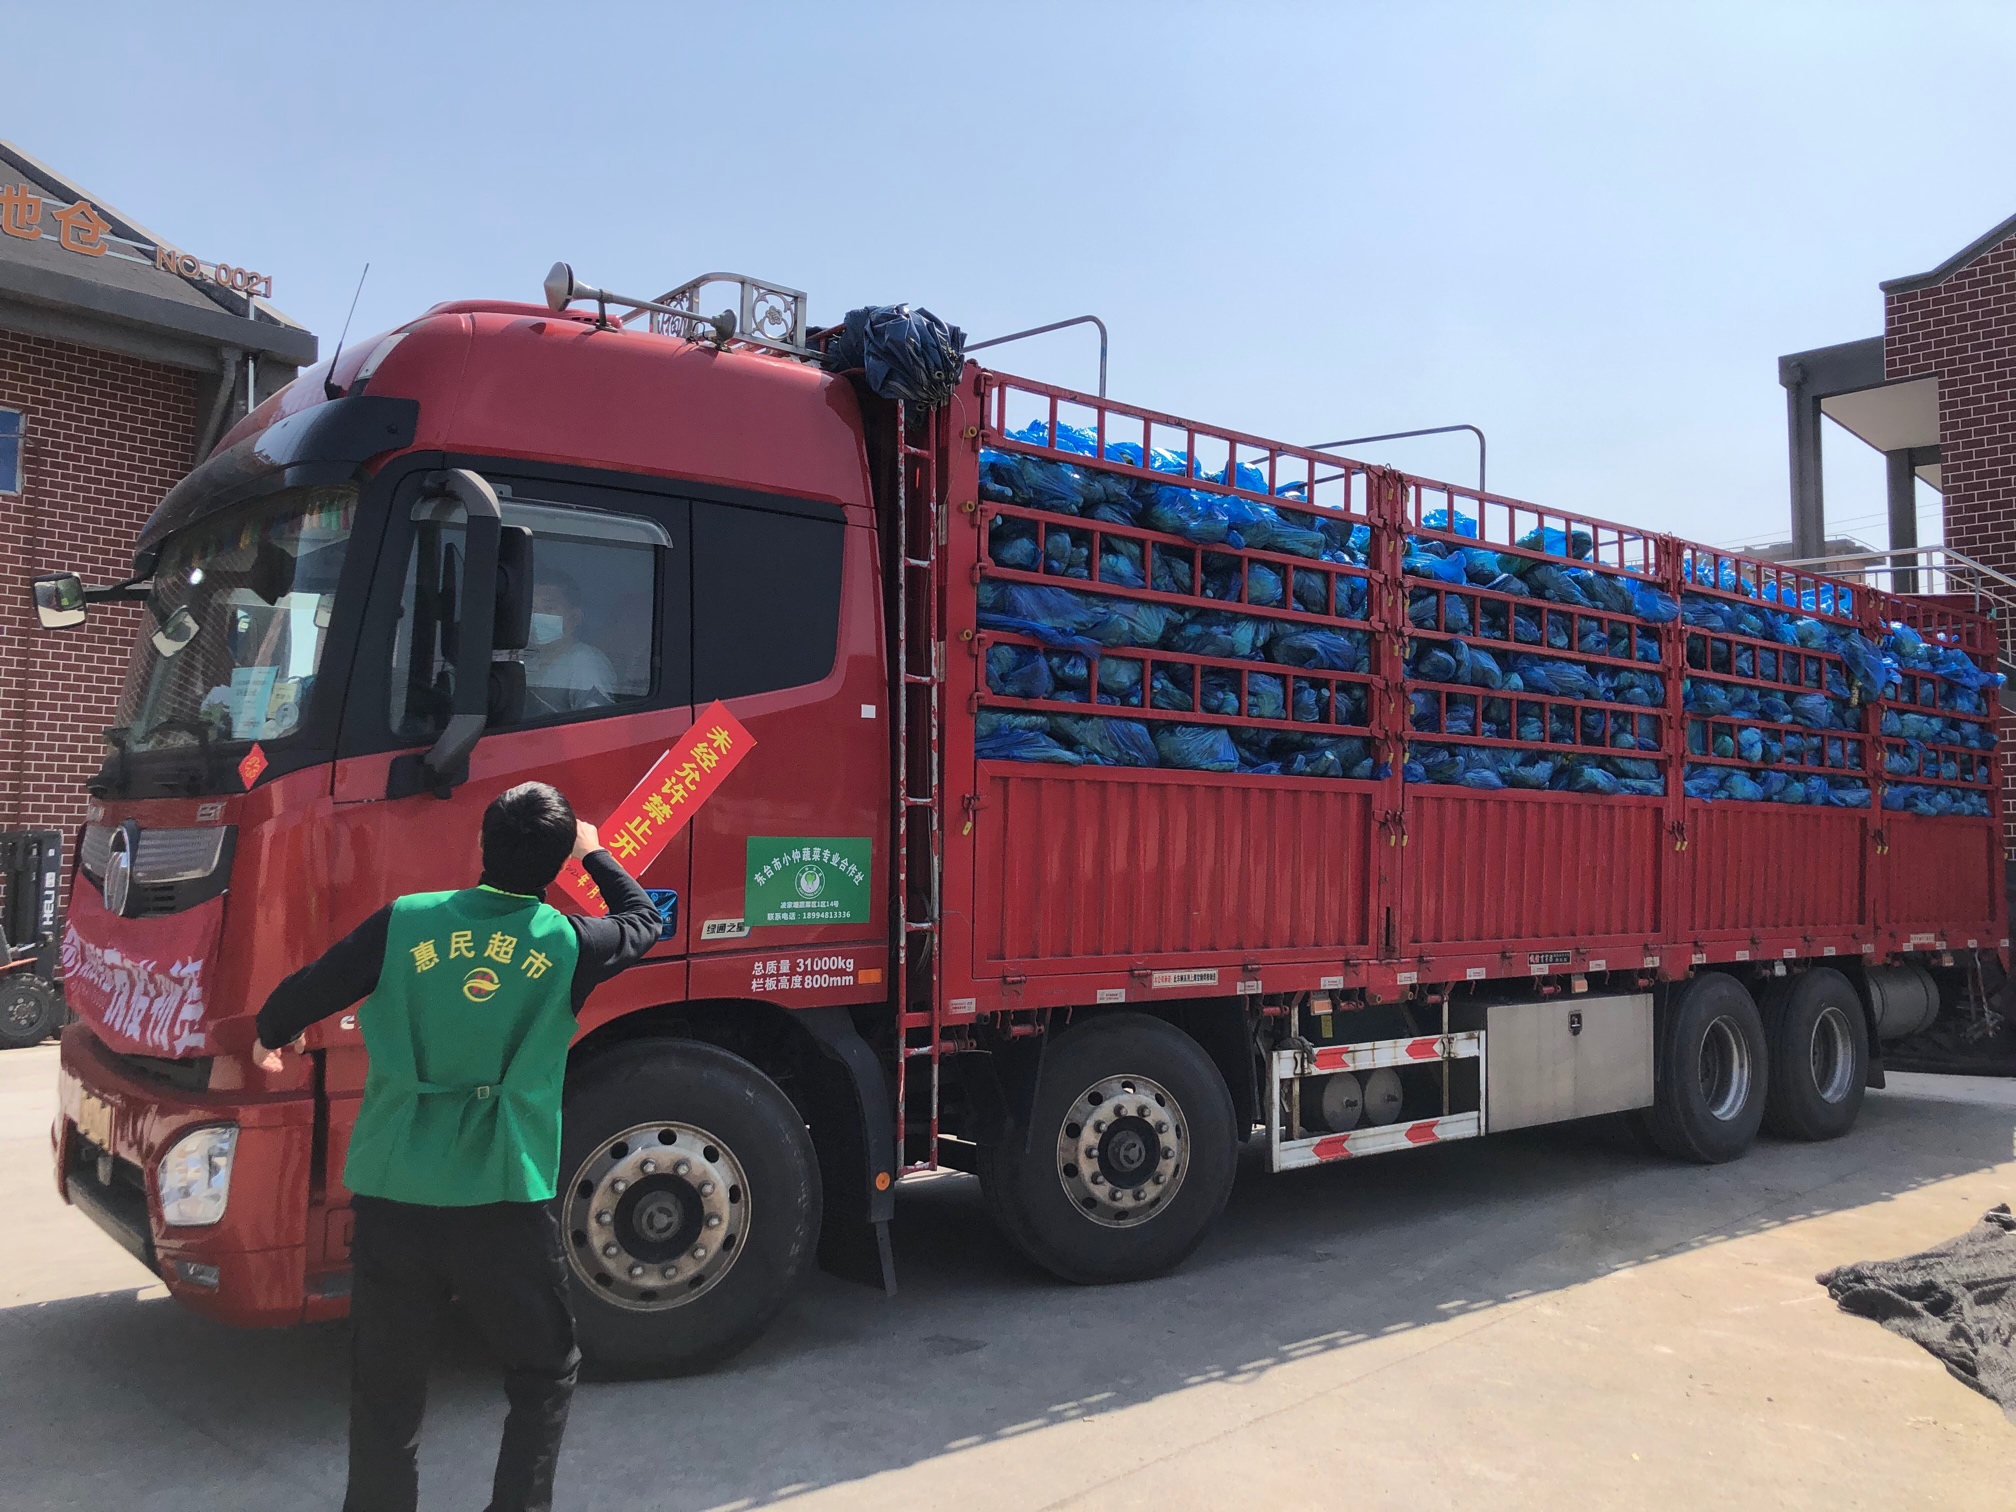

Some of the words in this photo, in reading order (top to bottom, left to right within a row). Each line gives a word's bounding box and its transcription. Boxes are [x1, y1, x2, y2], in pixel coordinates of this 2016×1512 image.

[155, 246, 273, 299] NO.0021
[409, 930, 553, 979] 惠民超市
[752, 959, 791, 976] 总质量
[796, 956, 854, 972] 31000kg
